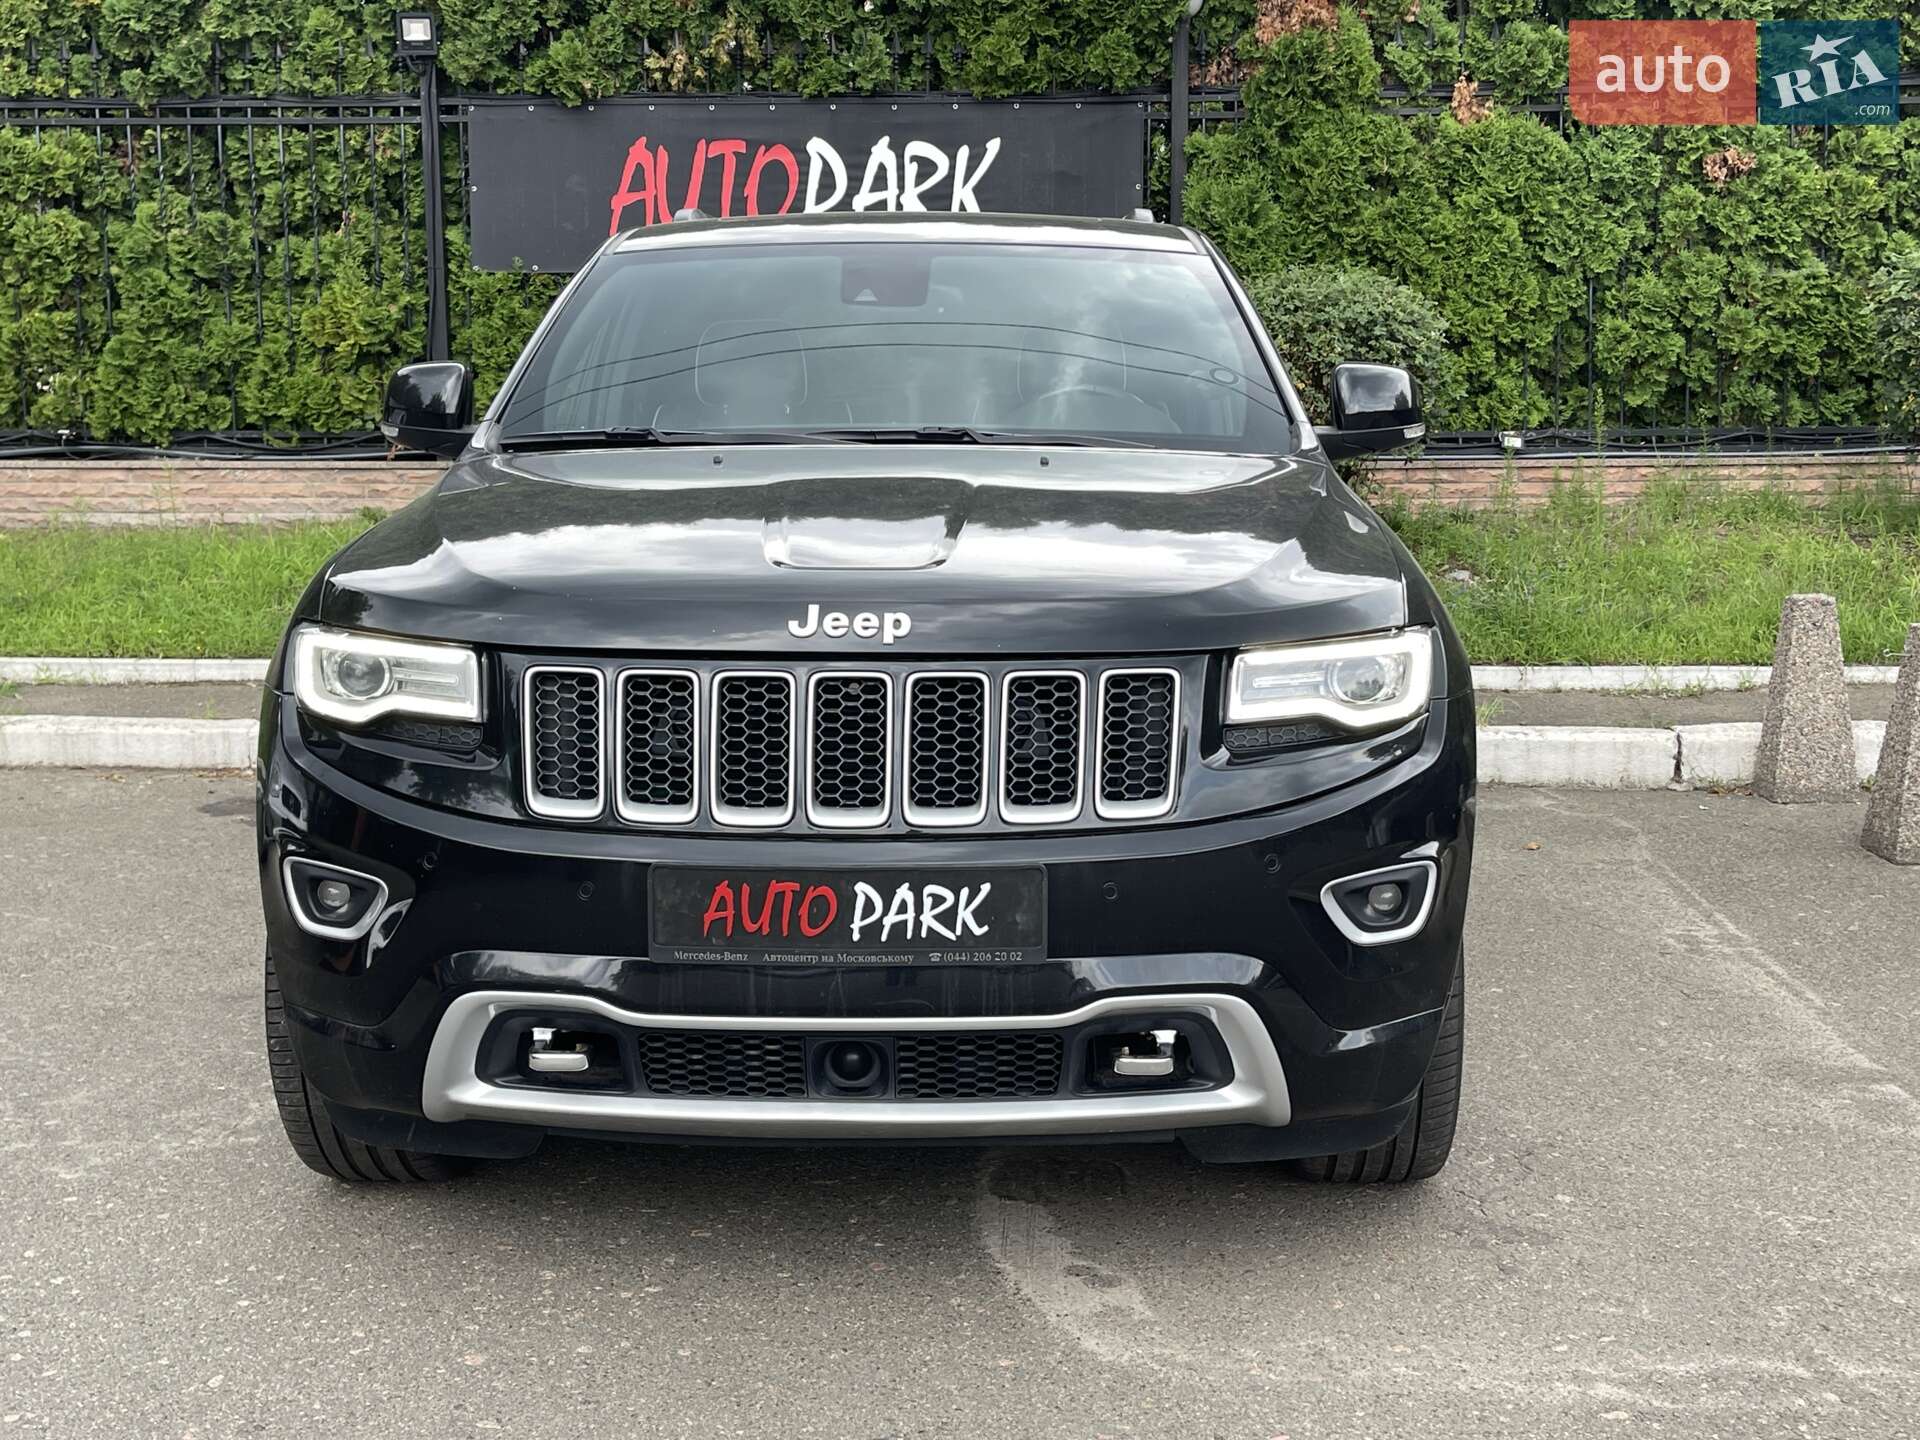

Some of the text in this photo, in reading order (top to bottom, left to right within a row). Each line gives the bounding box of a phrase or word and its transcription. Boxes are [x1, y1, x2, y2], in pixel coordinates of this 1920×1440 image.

[788, 604, 912, 644] Jeep
[703, 879, 992, 942] AUTO PARK
[673, 951, 749, 962] Mercedes-Benz
[762, 952, 915, 965] Автоцентр на Московському
[943, 951, 970, 962] (044)
[973, 951, 992, 962] 206
[1009, 951, 1023, 961] 02
